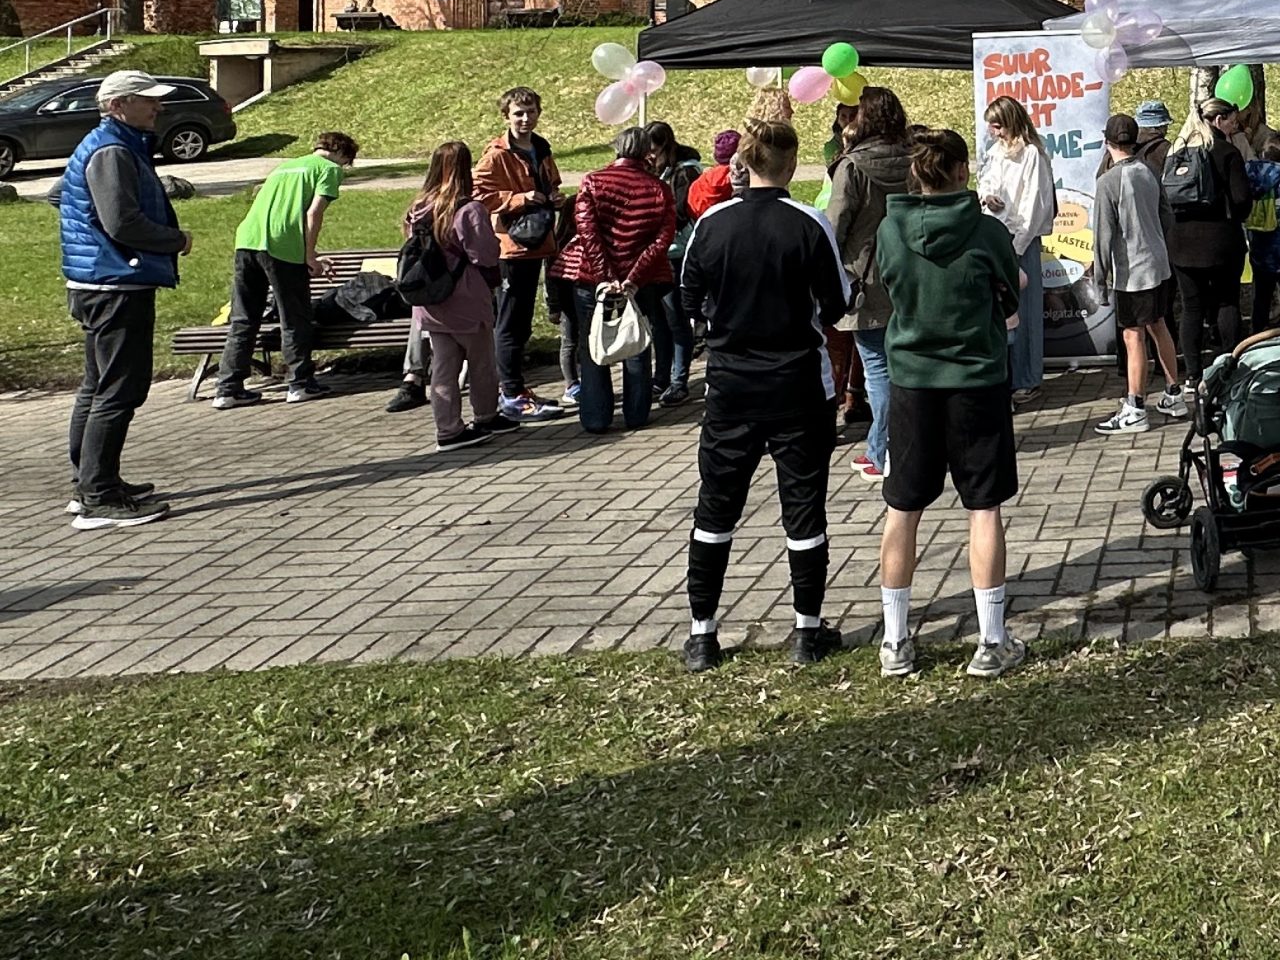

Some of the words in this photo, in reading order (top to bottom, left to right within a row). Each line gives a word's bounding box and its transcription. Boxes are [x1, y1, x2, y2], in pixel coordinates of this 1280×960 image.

[983, 48, 1052, 79] SUUR
[986, 72, 1104, 106] MUNADE-
[1024, 103, 1057, 128] HT
[1038, 130, 1103, 160] ME-
[1043, 308, 1088, 321] olgata.ee
